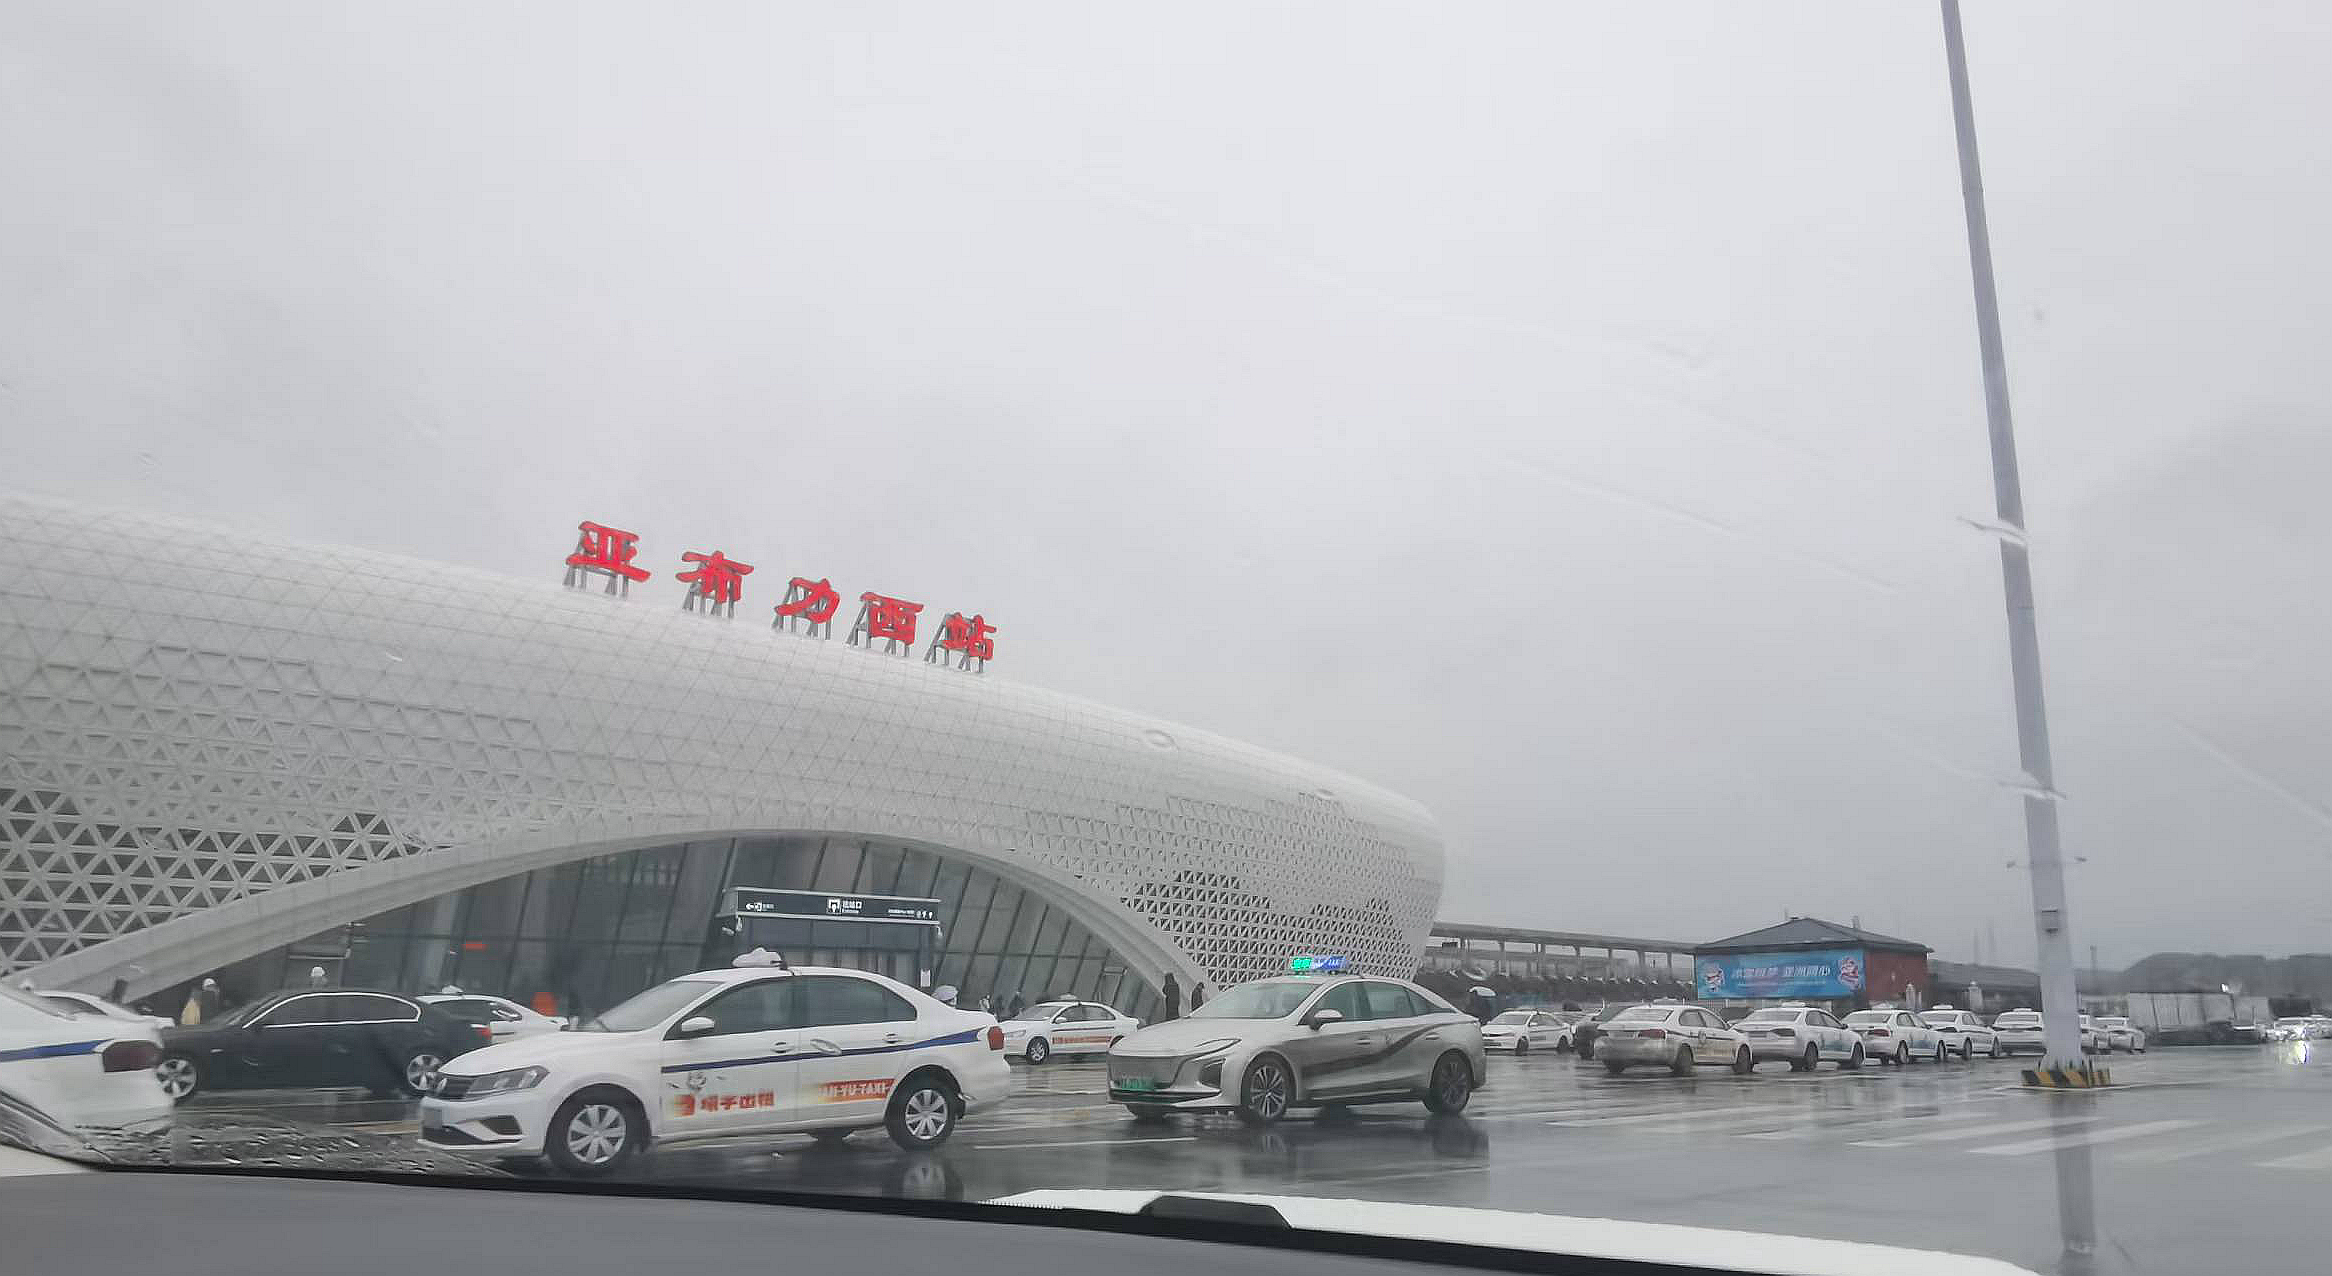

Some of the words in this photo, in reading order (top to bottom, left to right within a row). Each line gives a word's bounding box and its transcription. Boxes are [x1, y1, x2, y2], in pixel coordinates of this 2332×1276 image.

[566, 521, 995, 661] 亚布力西站
